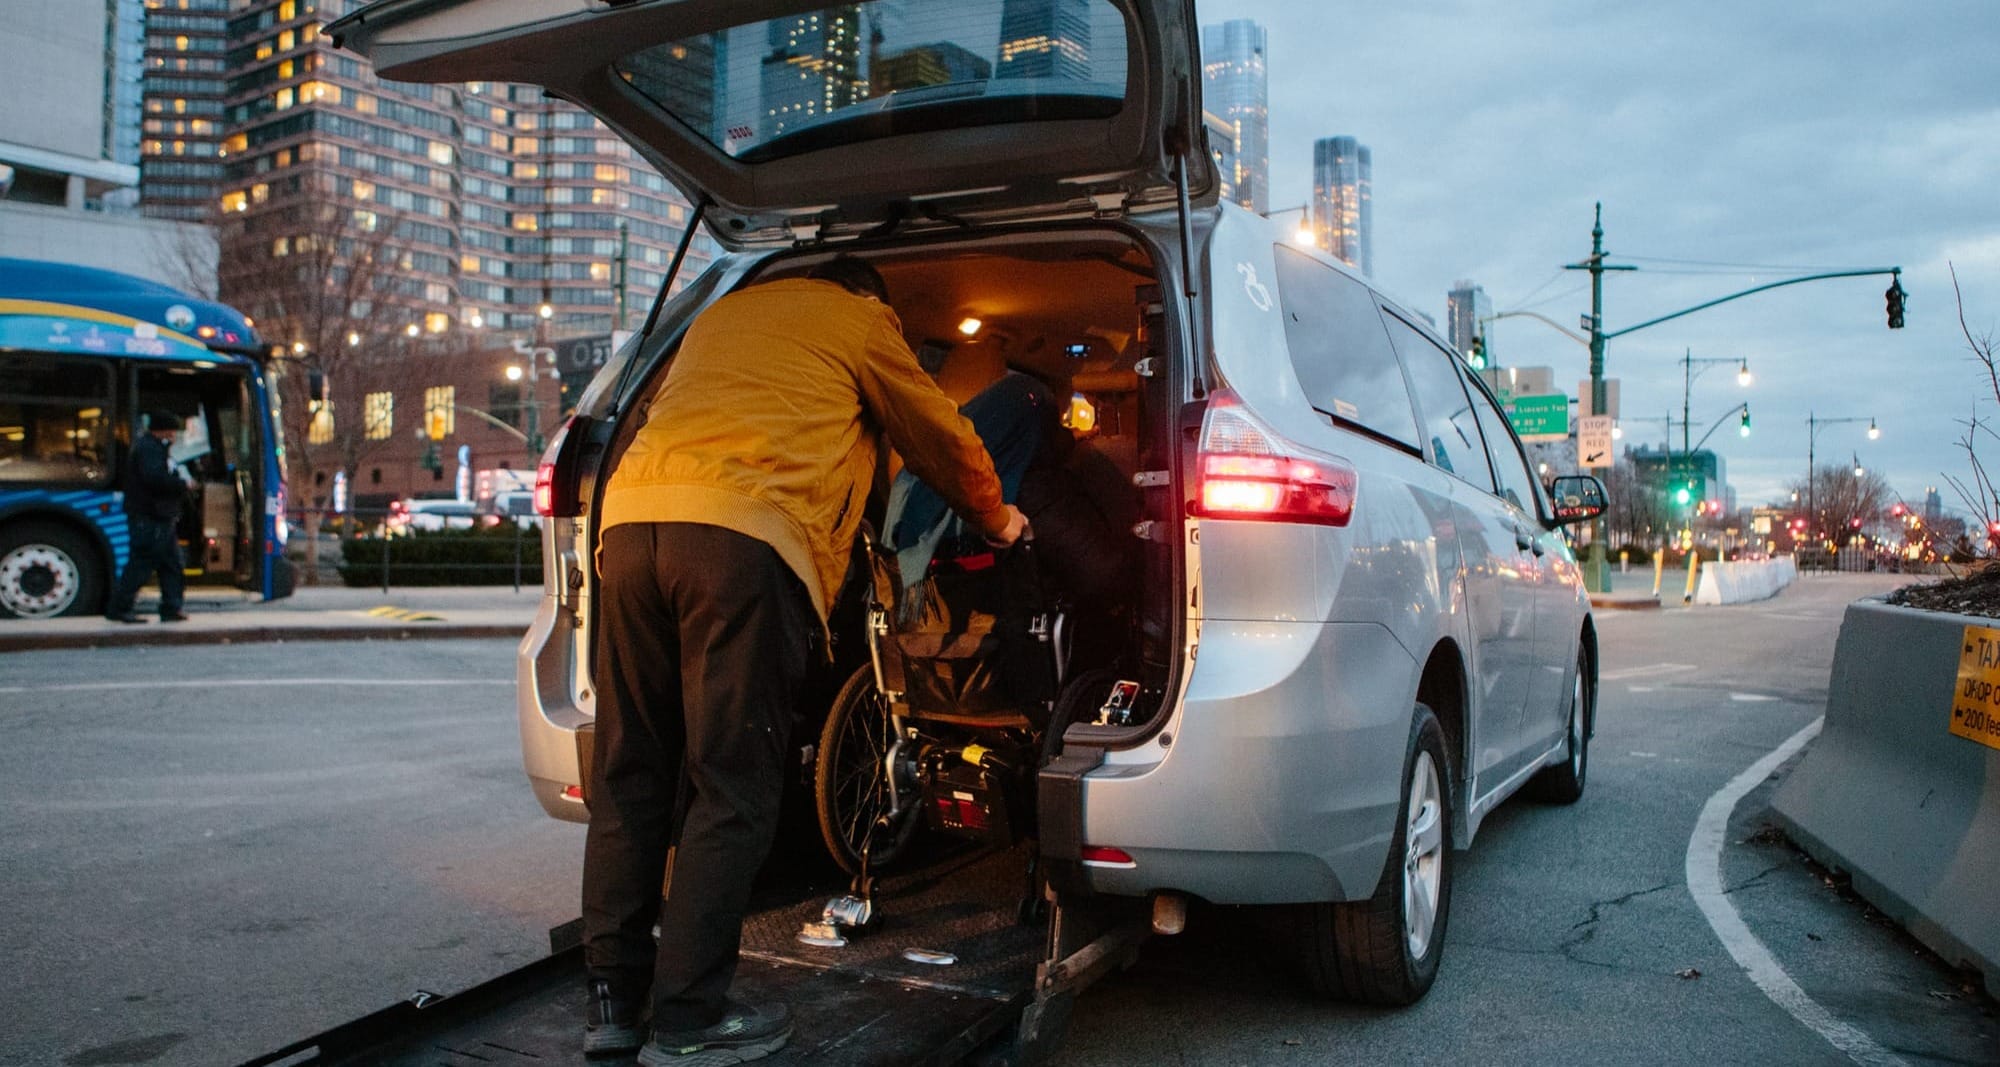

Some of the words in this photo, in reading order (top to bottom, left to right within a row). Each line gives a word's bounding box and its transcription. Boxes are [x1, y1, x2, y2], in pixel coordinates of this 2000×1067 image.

[1584, 421, 1607, 429] STOP
[1964, 678, 1992, 703] DROP
[1964, 708, 1984, 730] 200
